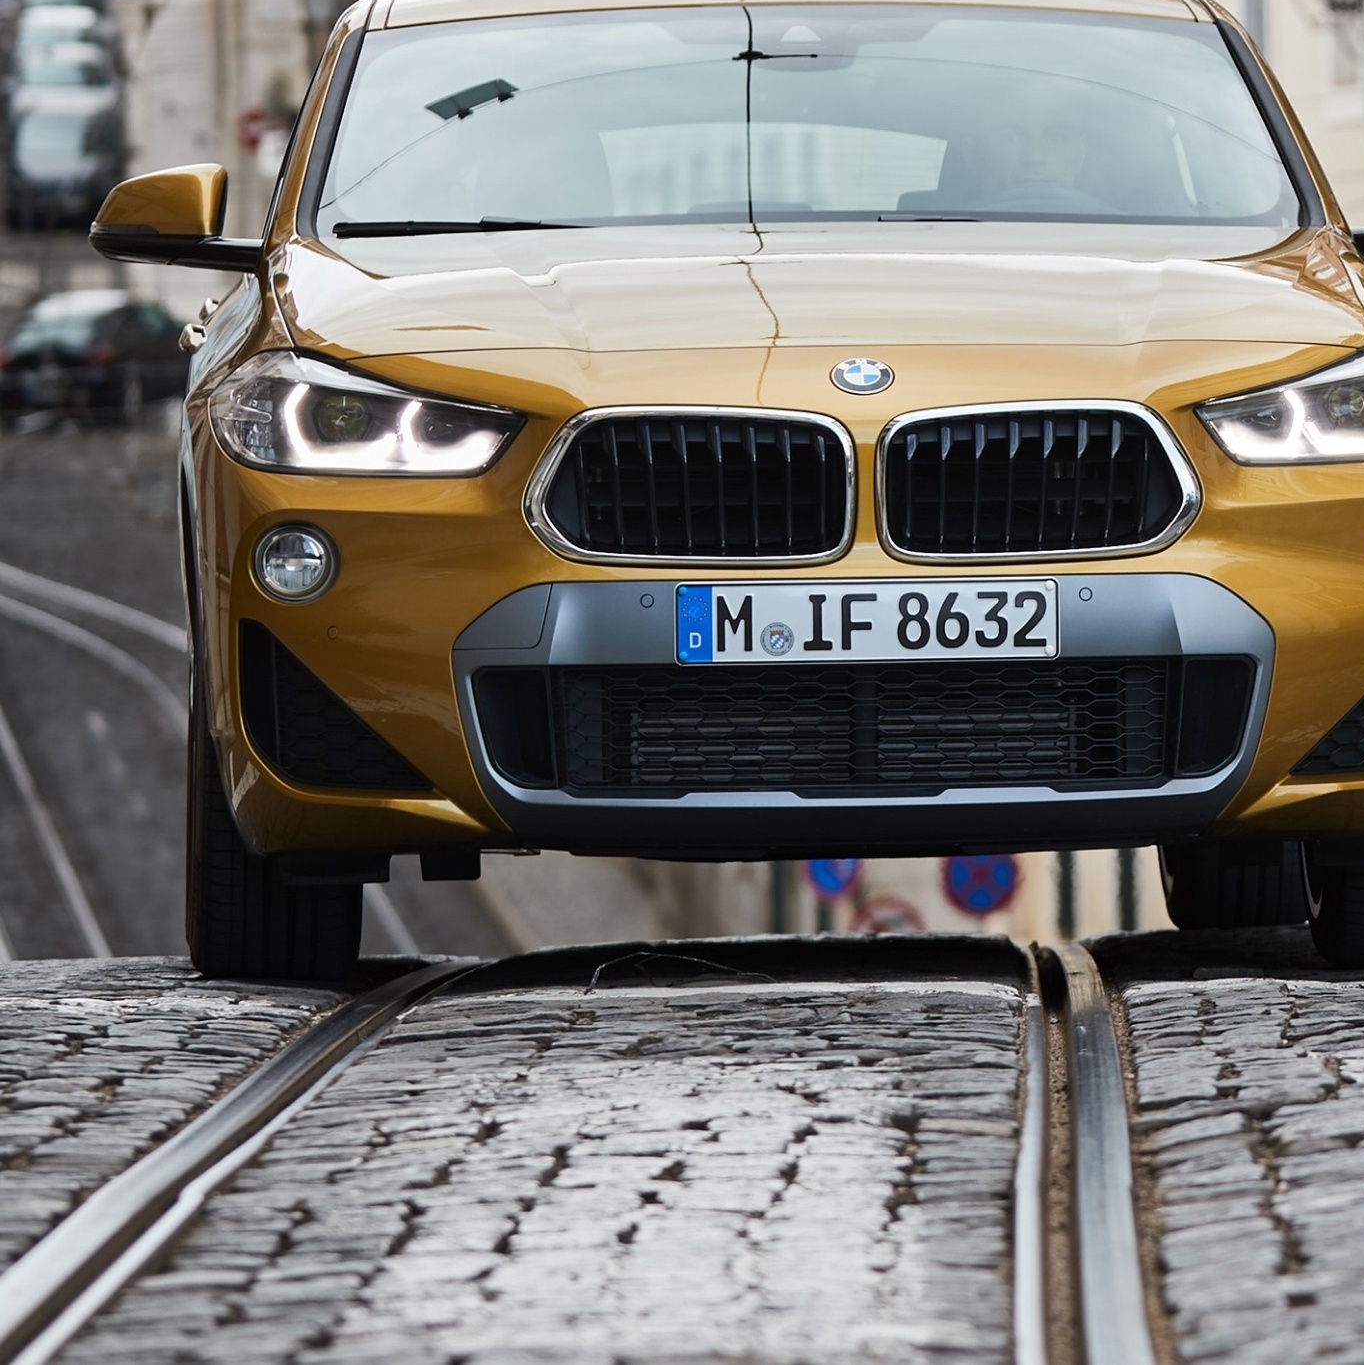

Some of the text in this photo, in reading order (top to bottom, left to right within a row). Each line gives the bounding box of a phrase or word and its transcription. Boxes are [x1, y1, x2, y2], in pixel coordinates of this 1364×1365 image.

[837, 358, 887, 370] BMW
[716, 595, 753, 652] M
[803, 593, 878, 651] IF
[896, 591, 1048, 650] 8632
[689, 632, 702, 649] D
